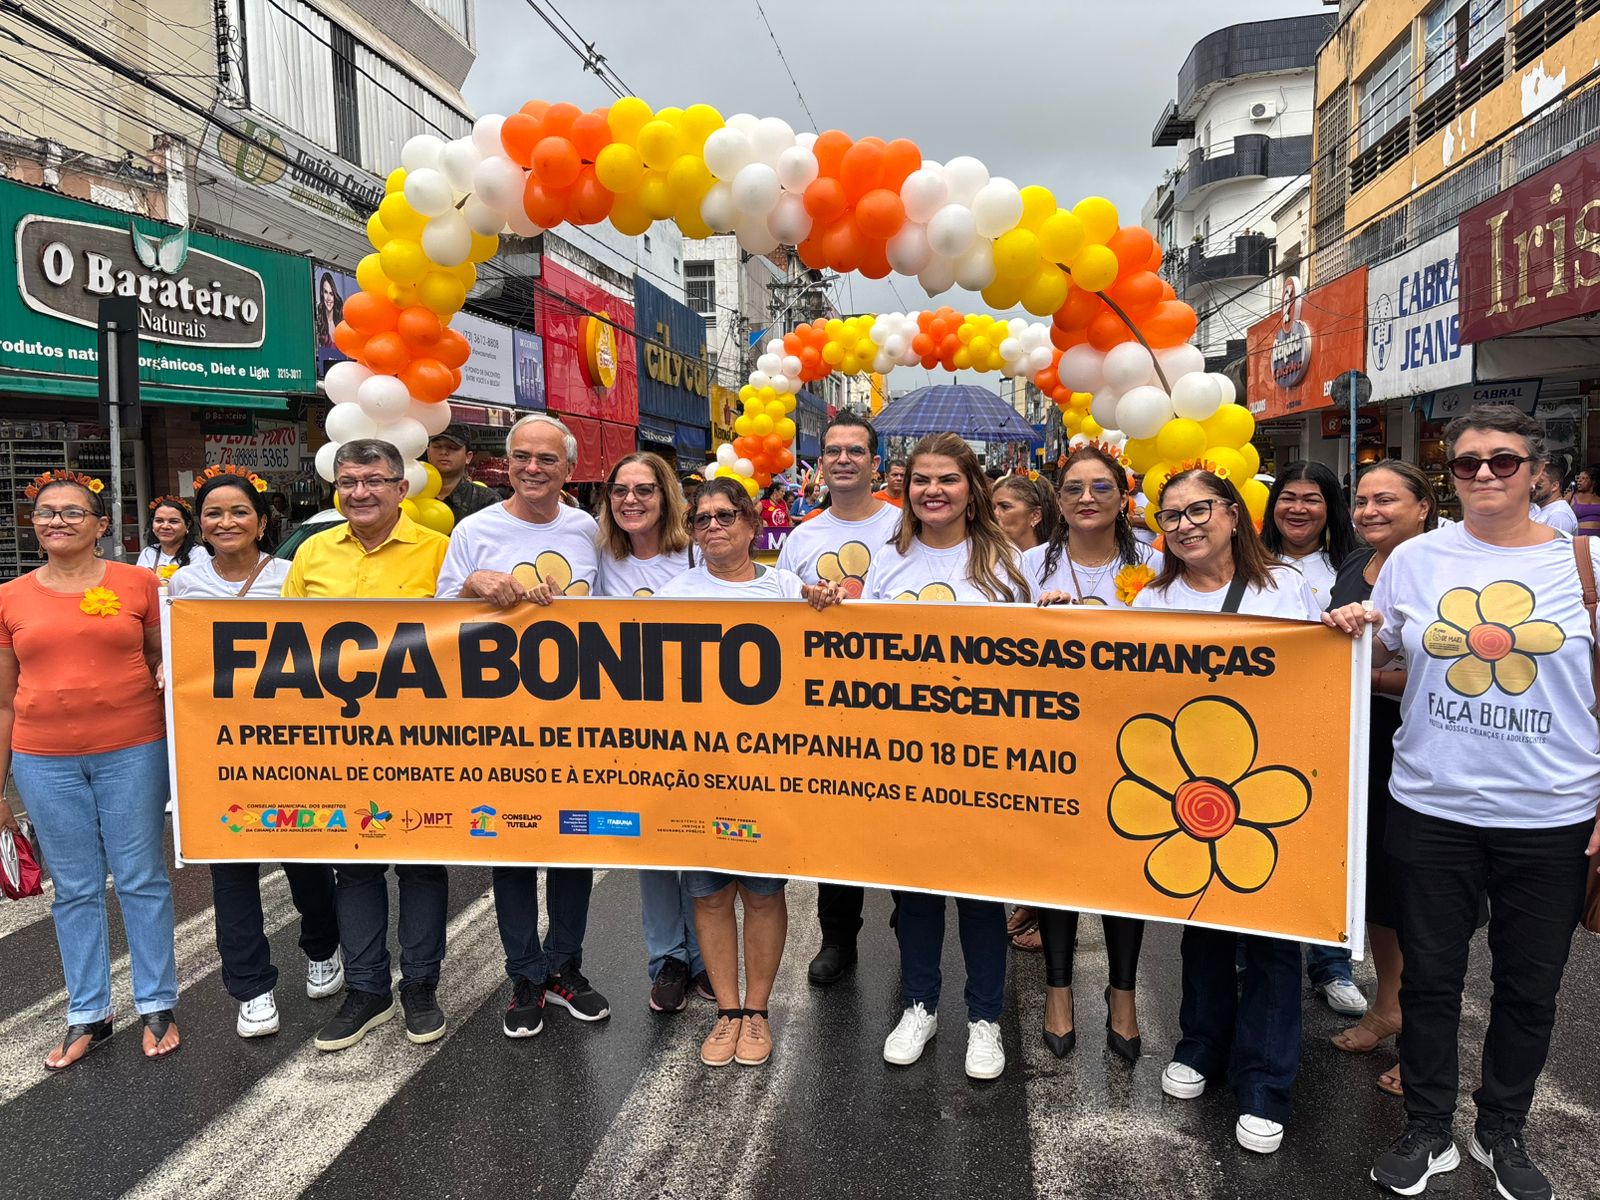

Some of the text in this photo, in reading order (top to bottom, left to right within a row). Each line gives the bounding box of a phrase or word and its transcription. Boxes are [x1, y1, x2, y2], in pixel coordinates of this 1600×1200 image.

[43, 242, 259, 324] O Barateiro
[1399, 255, 1459, 317] CABRA
[139, 307, 207, 338] Naturais
[1401, 313, 1461, 371] JEANS
[211, 362, 236, 375] Diet
[238, 366, 246, 375] e
[250, 366, 270, 380] Light
[1473, 388, 1523, 400] CABRAL
[213, 620, 782, 718] FAÇA BONITO
[804, 631, 1276, 683] PROTEJA NOSSAS CRIANÇAS
[804, 679, 1081, 721] E ADOLESCENTES
[1428, 692, 1552, 733] FAÇA BONITO
[216, 725, 1077, 775] A PREFEITURA MUNICIPAL DE ITABUNA NA CAMPANHA DO 18 DE MAIO
[218, 765, 1080, 816] DIA NACIONAL DE COMBATE AO ABUSO E À EXPLORAÇÃO SEXUAL DE CRIANÇAS E ADOLESCENTES
[260, 809, 347, 828] CMDCA
[423, 812, 453, 825] MPT
[502, 813, 542, 821] CONSELHO
[507, 821, 538, 829] TUTELAR
